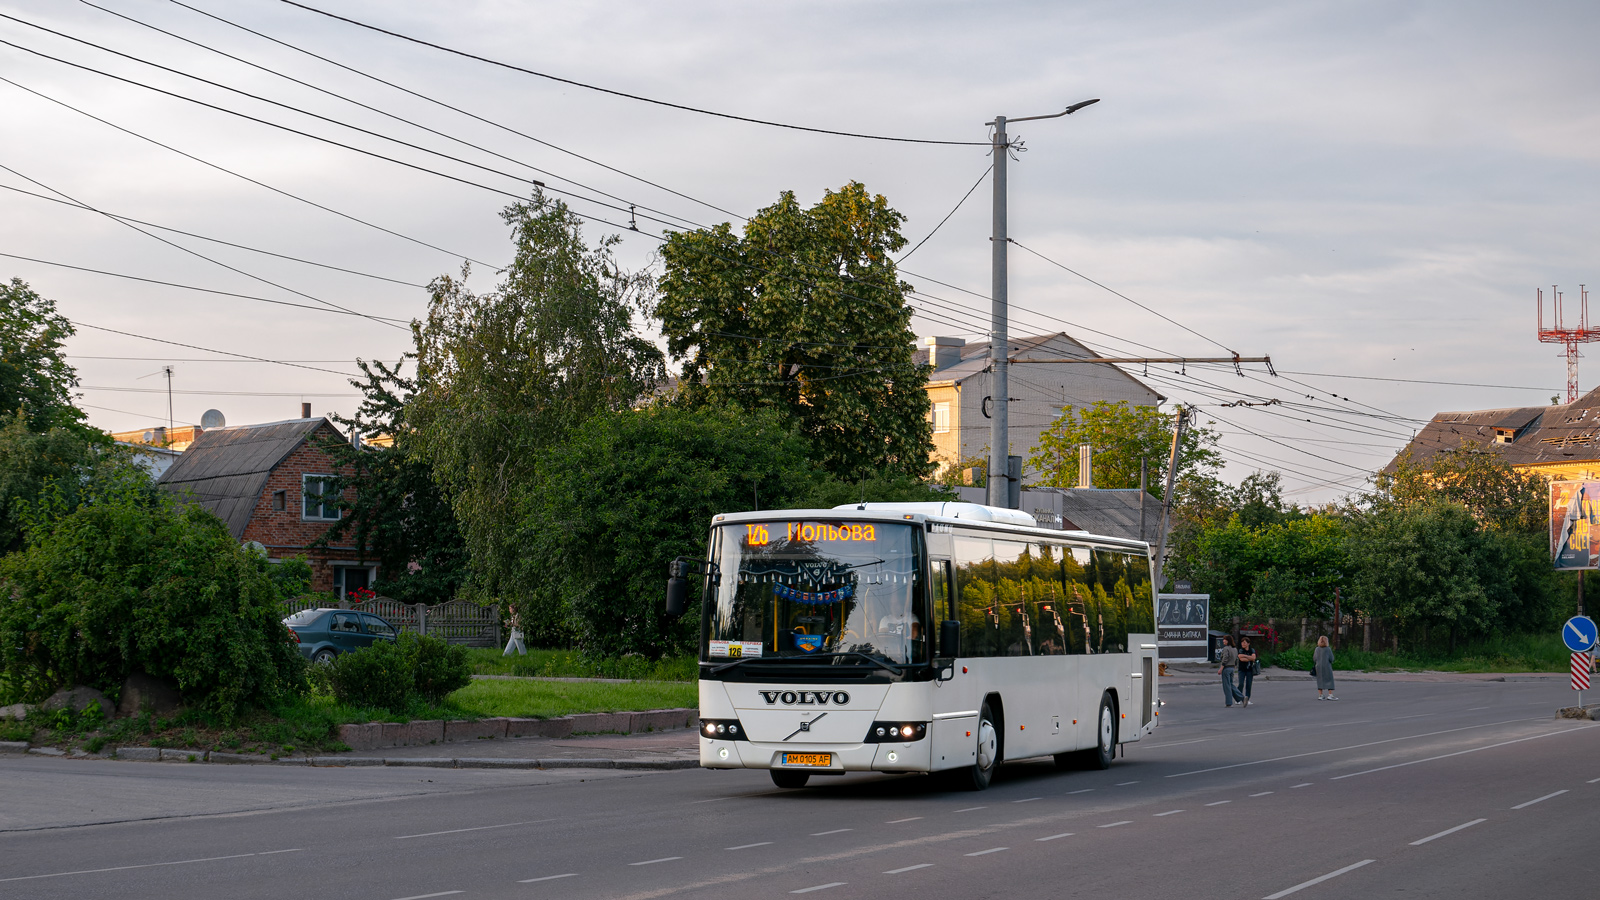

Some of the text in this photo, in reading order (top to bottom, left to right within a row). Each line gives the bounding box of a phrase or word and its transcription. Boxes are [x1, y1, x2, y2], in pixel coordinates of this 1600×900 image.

[745, 524, 769, 545] 126
[728, 647, 742, 657] 126
[758, 690, 850, 705] VOLVO
[787, 755, 830, 763] AM 0105 AF
